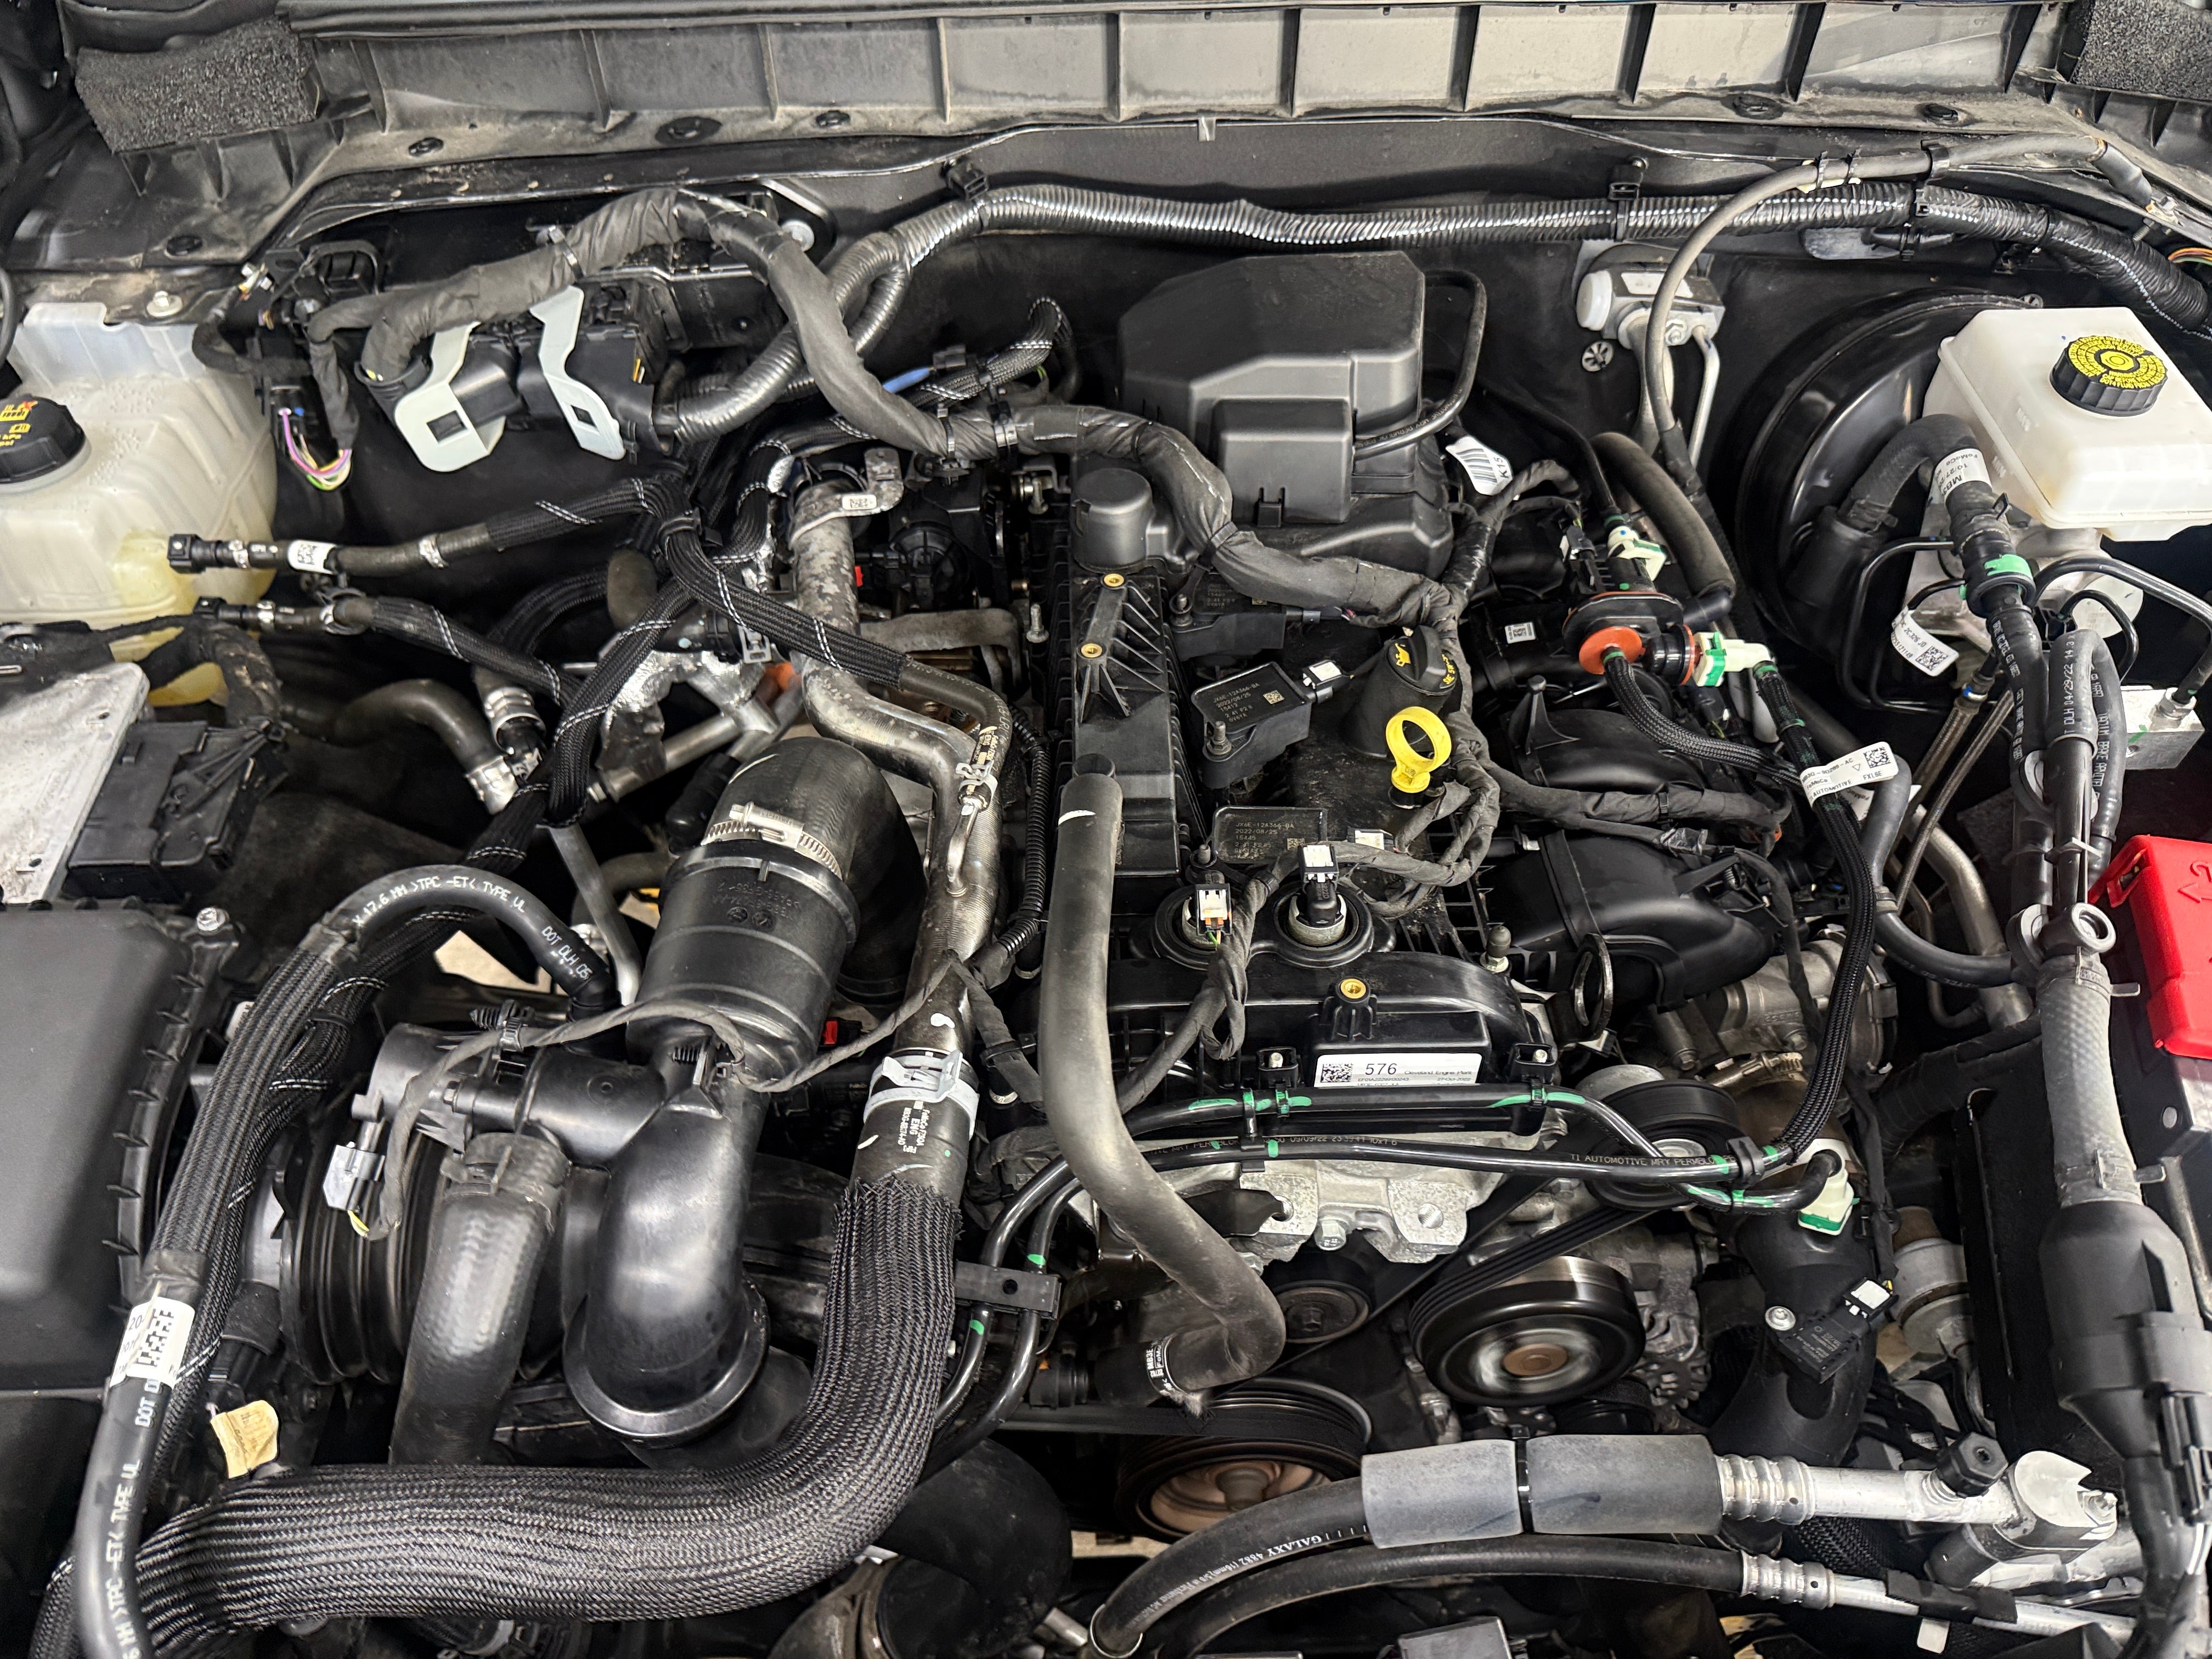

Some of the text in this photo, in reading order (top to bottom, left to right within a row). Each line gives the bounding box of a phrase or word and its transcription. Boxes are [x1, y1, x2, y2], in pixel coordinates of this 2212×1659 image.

[1493, 457, 1509, 478] K15
[1946, 453, 1978, 466] FoMoCo
[1442, 674, 1455, 685] SAE
[1813, 780, 1852, 797] AUTOMOTIVE
[482, 881, 511, 901] TYPE
[541, 926, 563, 945] DOT
[1365, 1063, 1398, 1075] 576
[909, 1118, 921, 1135] ENG
[1584, 1155, 1647, 1166] AUTOMOTIVE
[1650, 1156, 1672, 1166] MRY
[110, 1483, 133, 1525] TYPE
[134, 1397, 156, 1428] DOT
[1266, 1535, 1322, 1558] GALAXY
[1238, 1552, 1263, 1566] 4882
